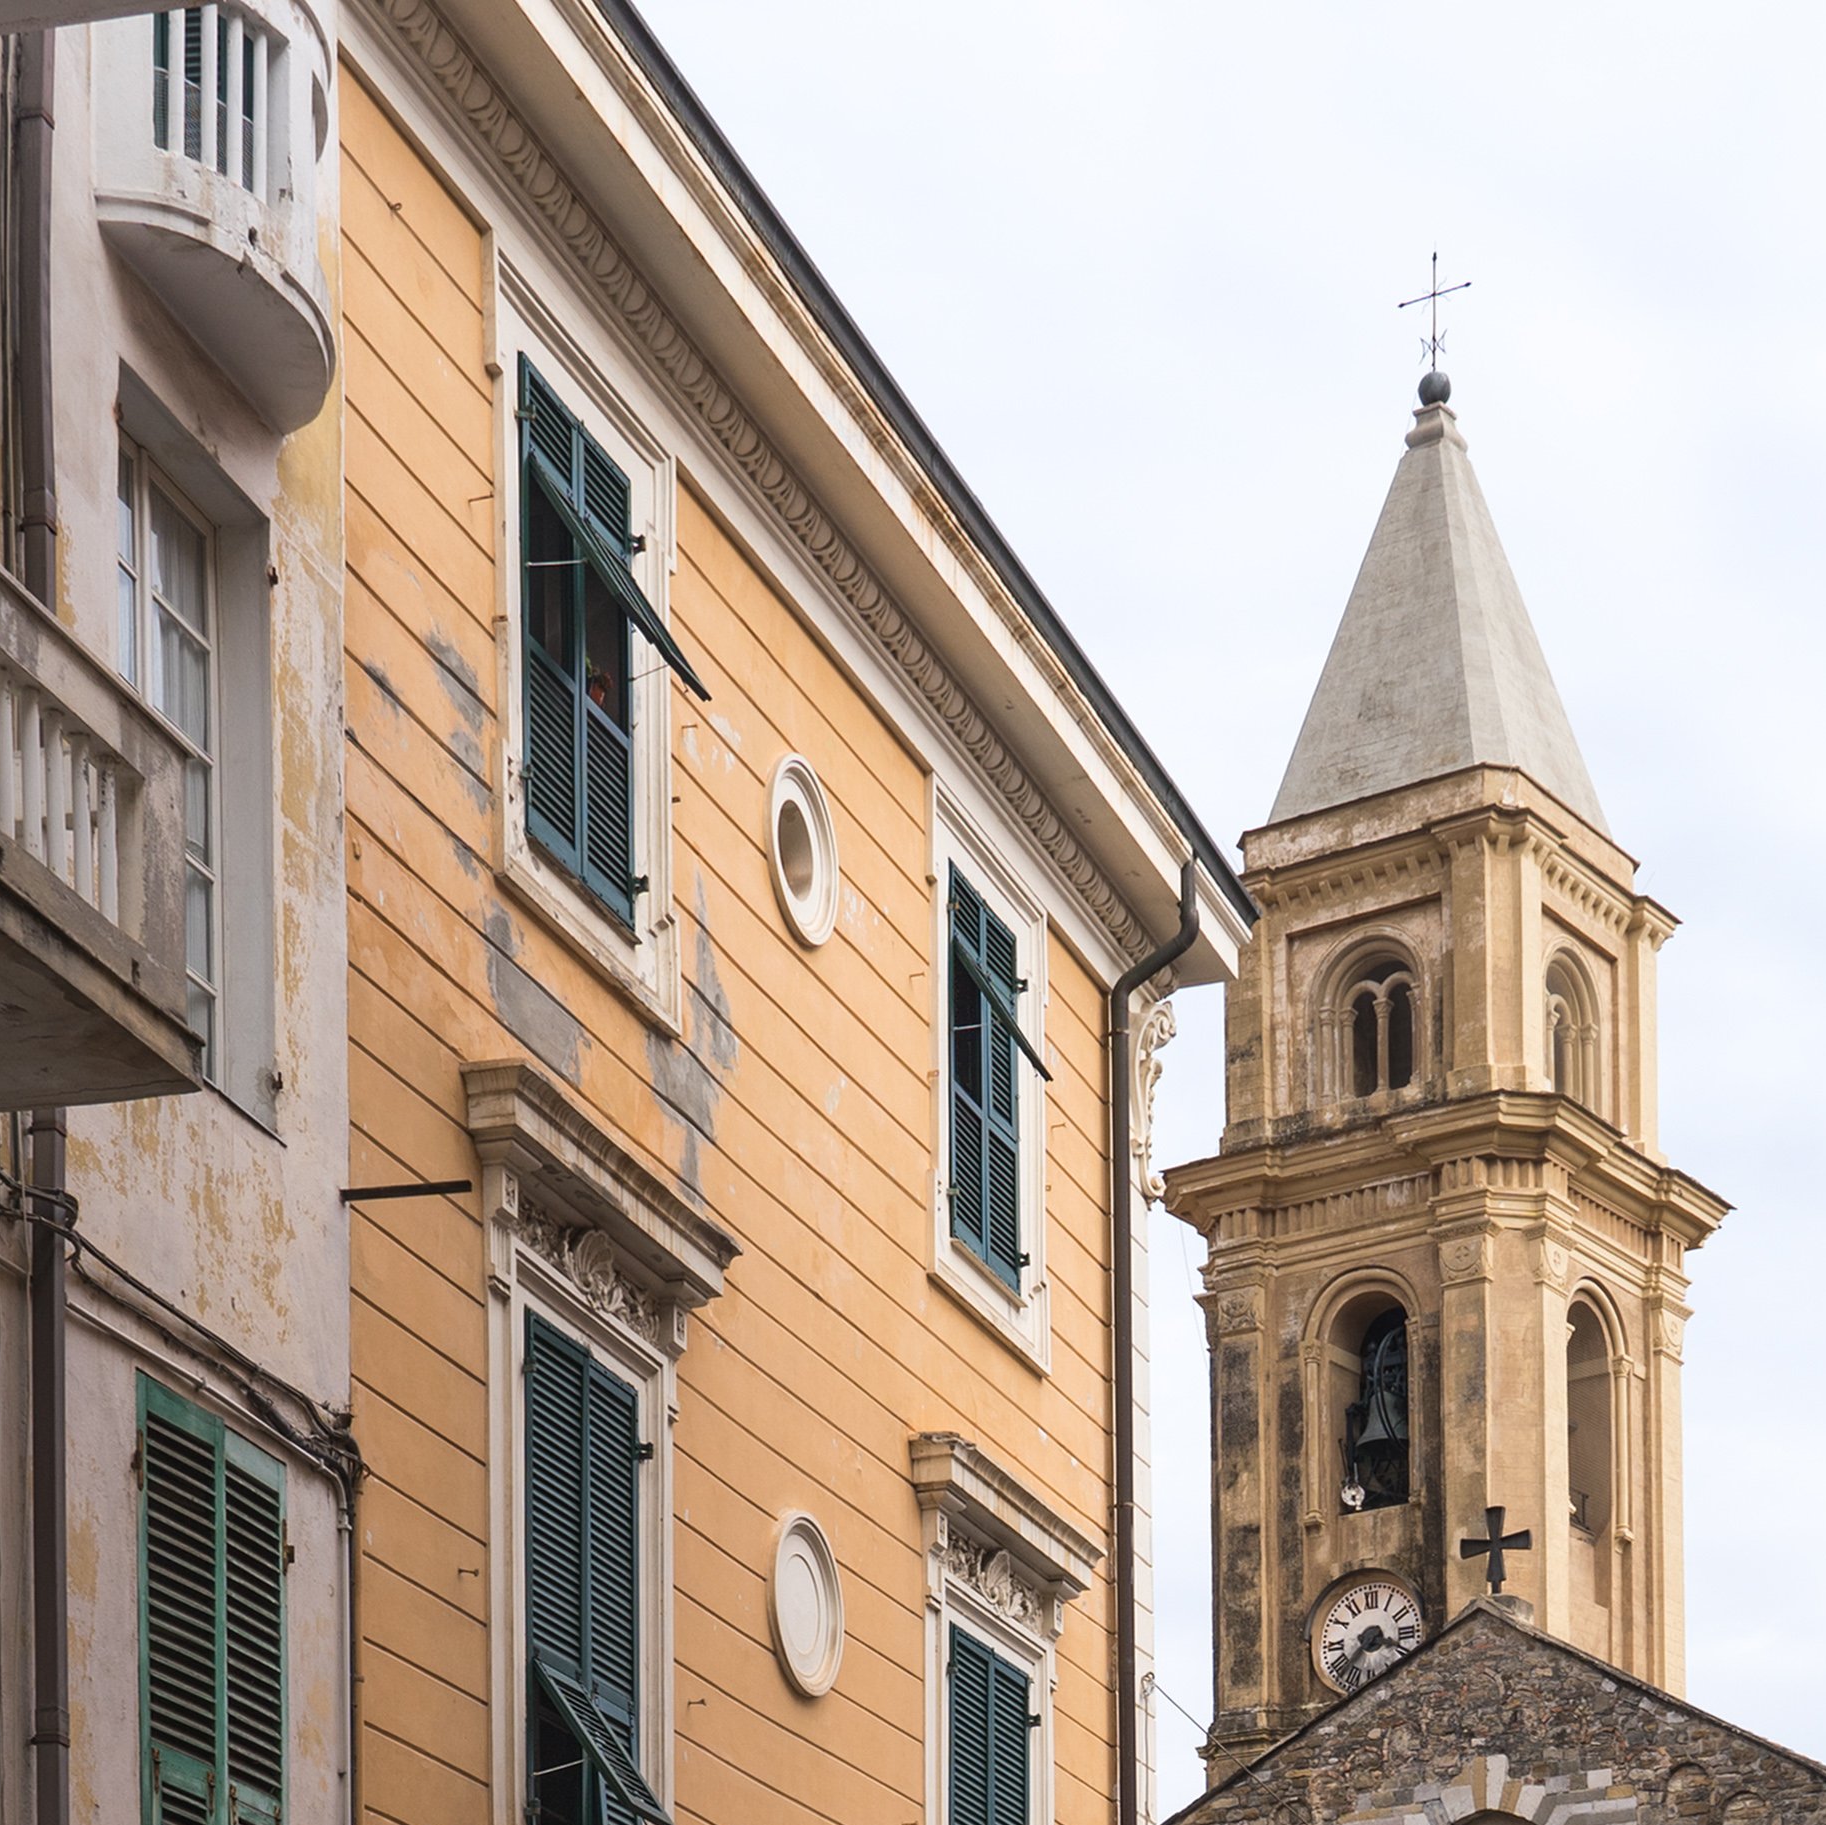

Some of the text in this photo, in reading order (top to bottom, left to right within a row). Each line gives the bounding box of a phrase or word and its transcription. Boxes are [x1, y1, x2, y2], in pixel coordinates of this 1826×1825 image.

[1345, 1599, 1362, 1619] XI
[1364, 1591, 1378, 1610] XII
[1383, 1594, 1393, 1612] I
[1392, 1605, 1410, 1623] II
[1333, 1618, 1350, 1630] X
[1398, 1625, 1415, 1640] III
[1328, 1639, 1344, 1652] IX
